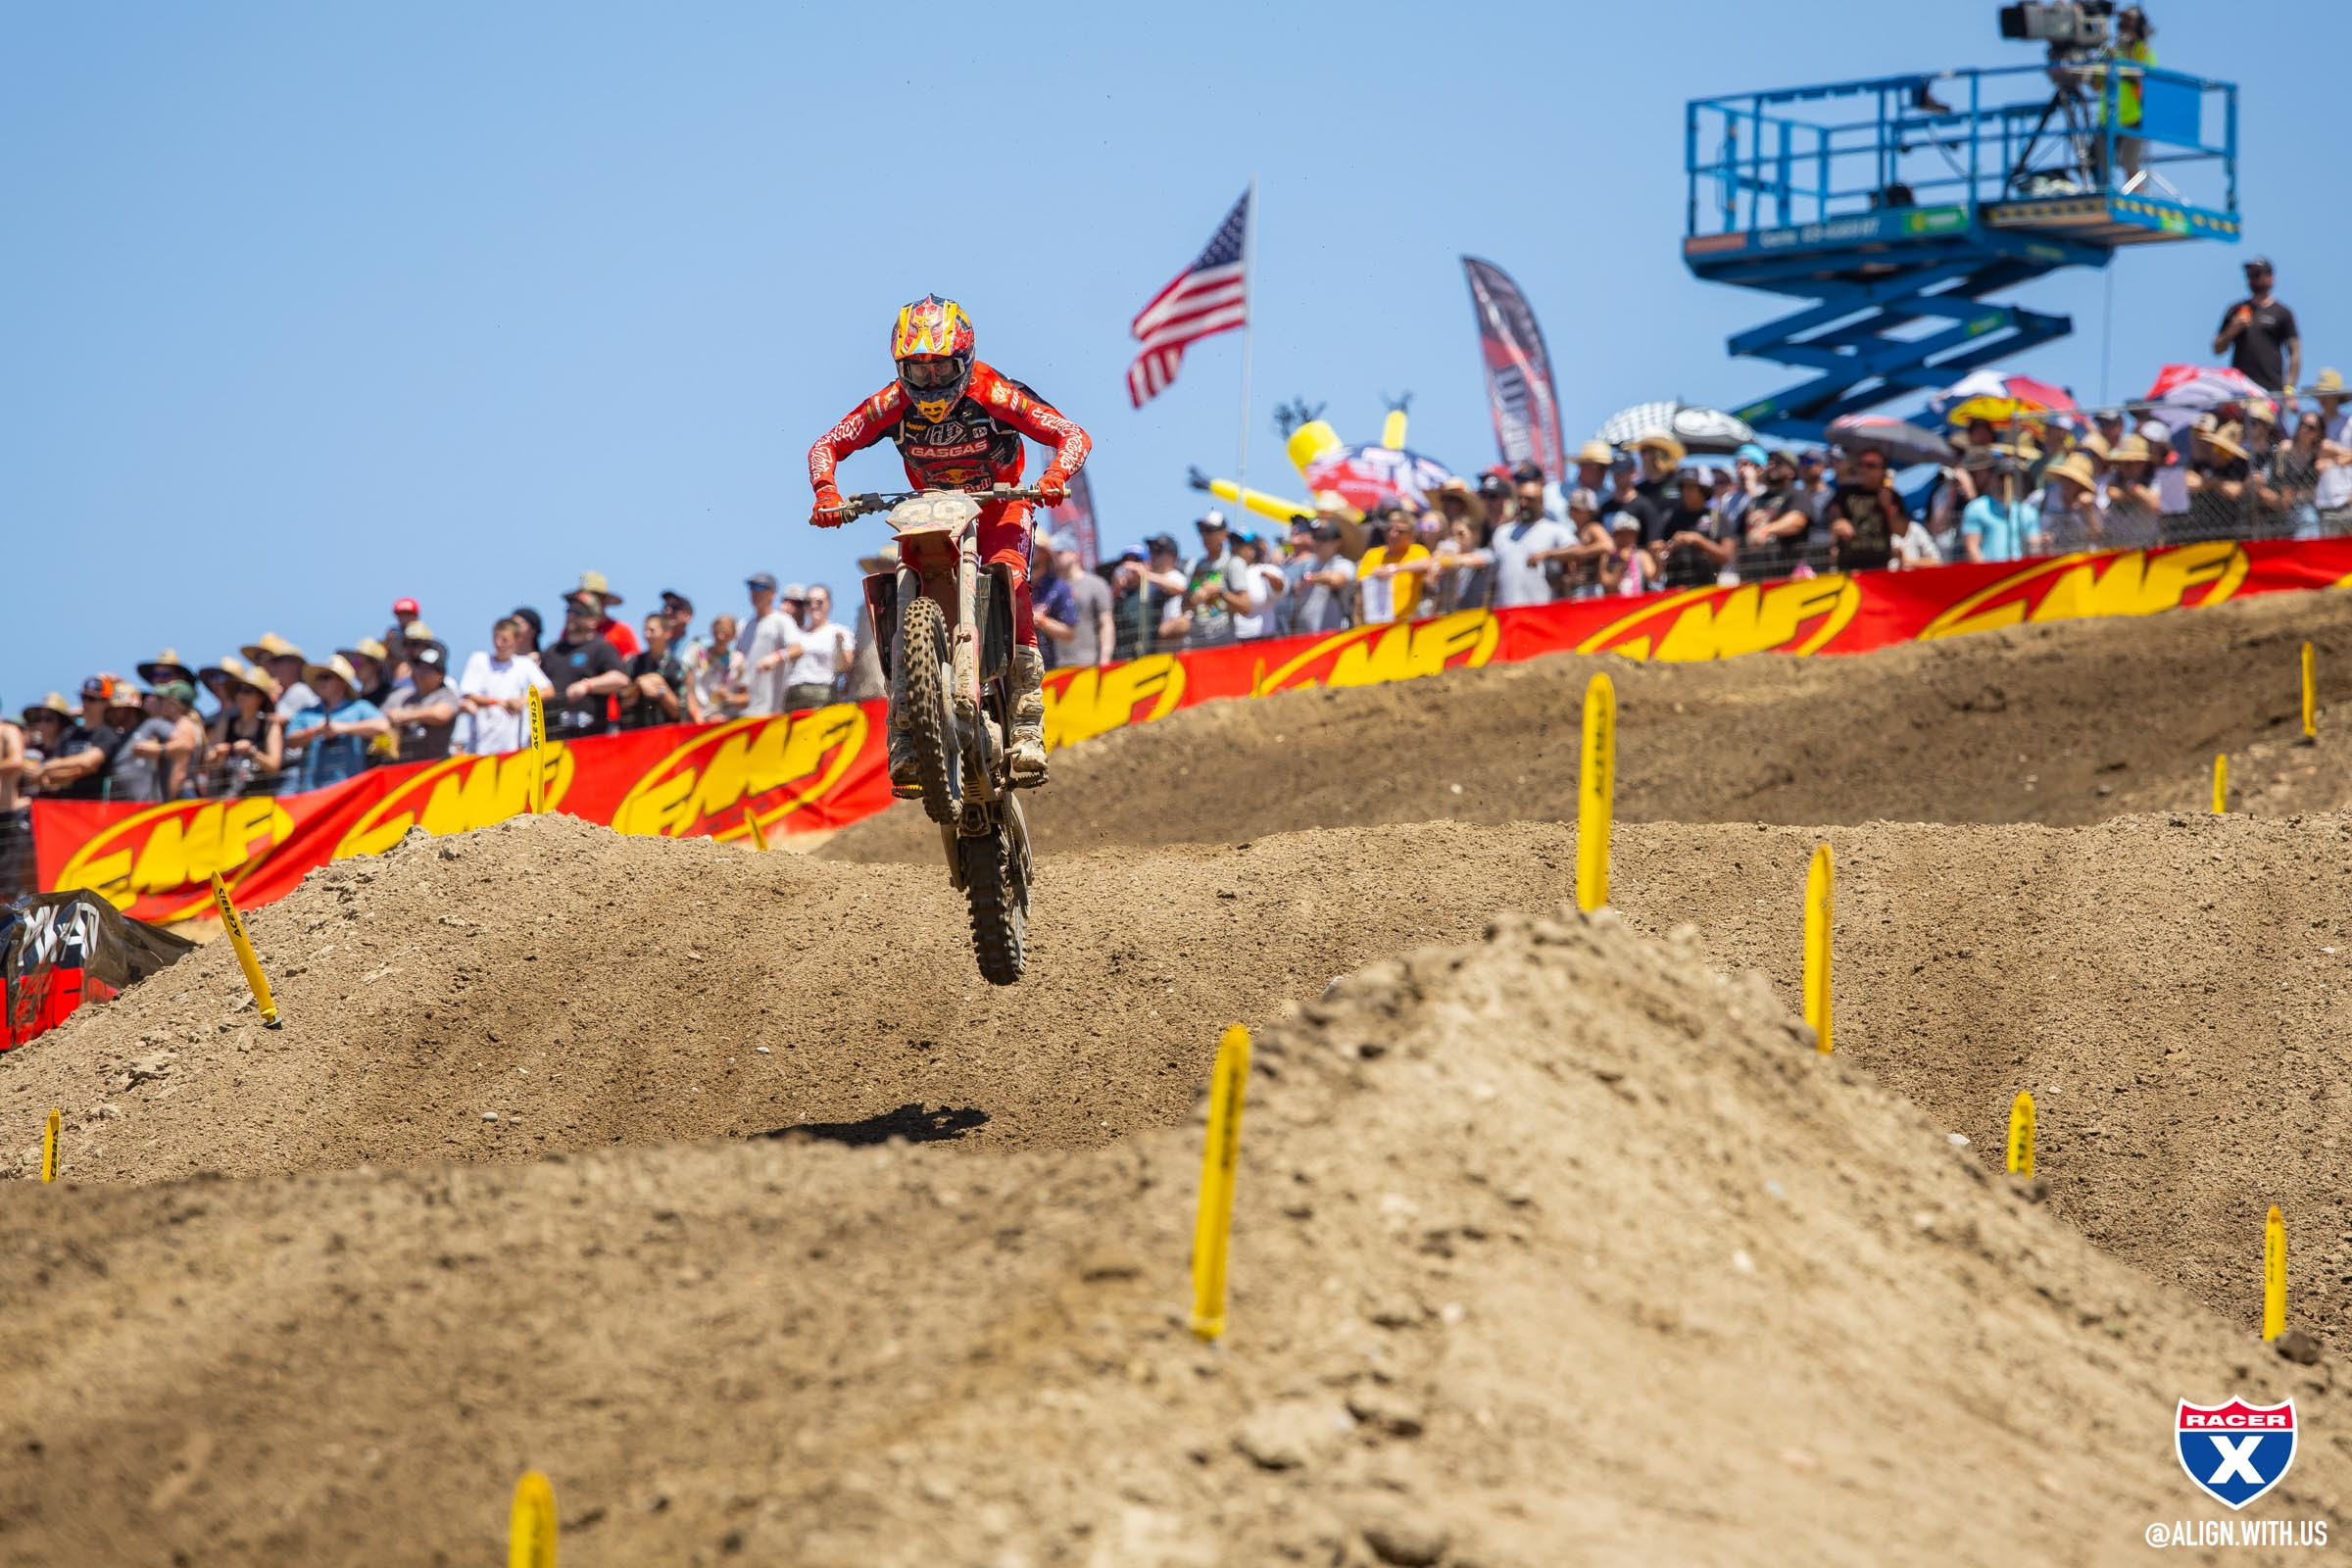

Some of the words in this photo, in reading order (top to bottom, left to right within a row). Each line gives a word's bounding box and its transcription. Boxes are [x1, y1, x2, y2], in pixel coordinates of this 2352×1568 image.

[910, 439, 988, 458] GASGAS
[1042, 653, 1174, 754] MF
[626, 703, 858, 837] FMF
[70, 796, 274, 911] FMF
[219, 887, 242, 939] ACERBIS
